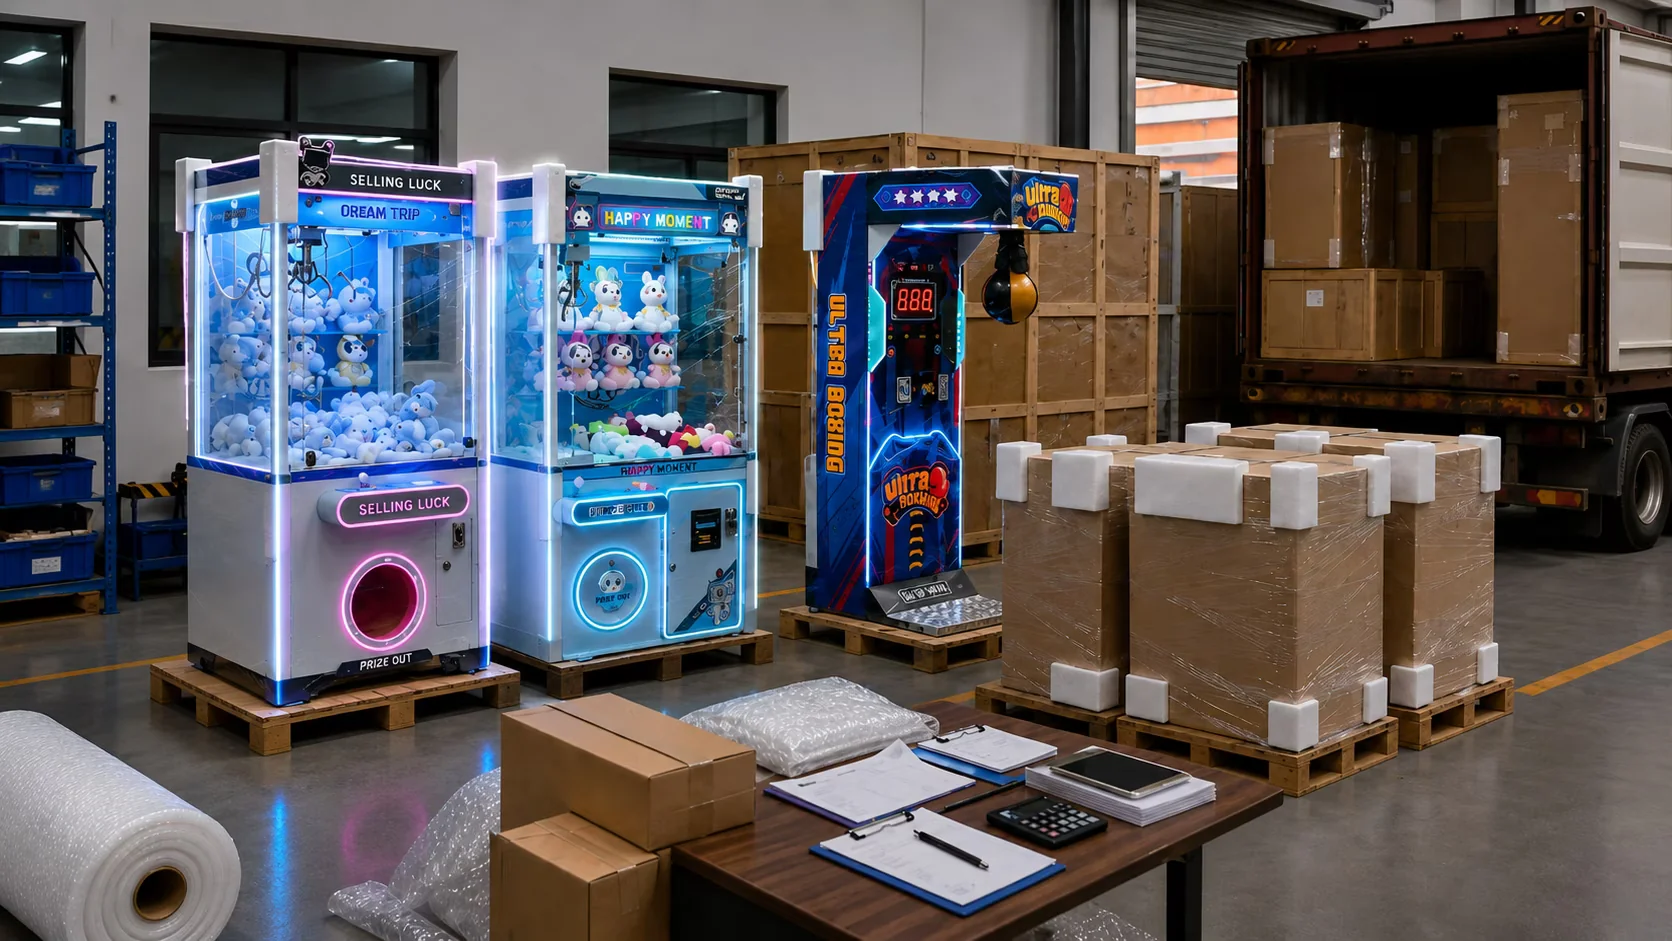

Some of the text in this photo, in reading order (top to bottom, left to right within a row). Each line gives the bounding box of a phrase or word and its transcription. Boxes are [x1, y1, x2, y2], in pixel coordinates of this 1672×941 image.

[350, 174, 442, 191] SELLING LUCK
[391, 207, 420, 221] TRIP
[604, 210, 712, 230] HAPPY MOMENT
[359, 496, 450, 516] SELLING LUCK
[392, 652, 413, 665] OUT
